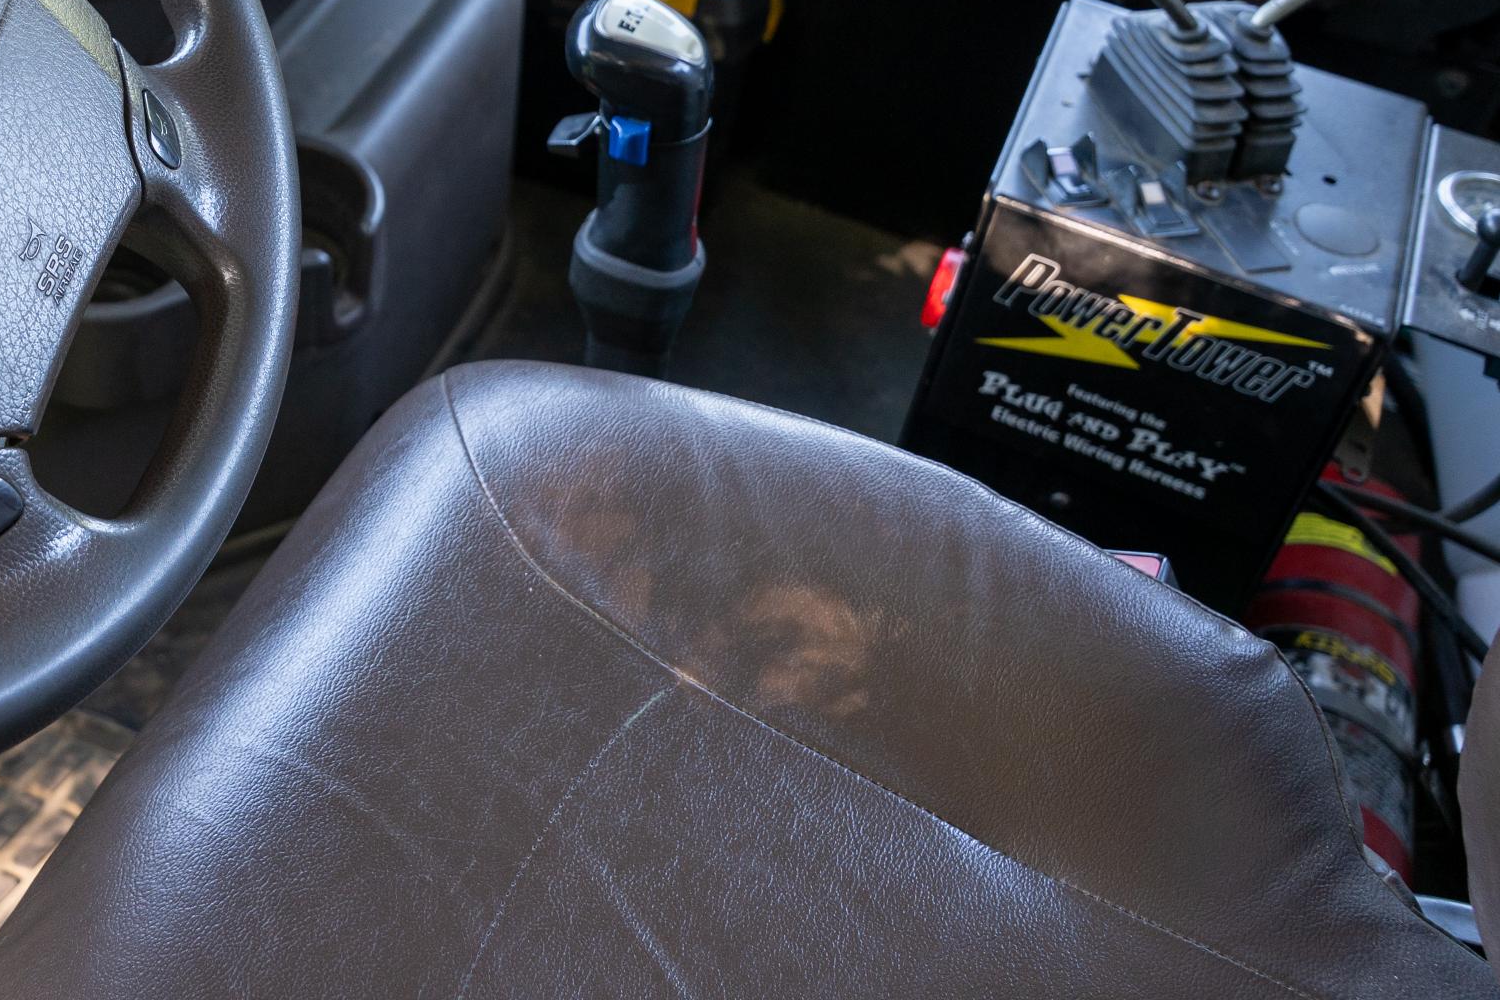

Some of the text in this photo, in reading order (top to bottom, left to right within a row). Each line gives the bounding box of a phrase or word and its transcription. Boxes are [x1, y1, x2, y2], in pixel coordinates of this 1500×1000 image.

[37, 235, 74, 297] SRS
[53, 248, 84, 306] AIRBAG
[991, 404, 1207, 500] Electric Wiring Harness
